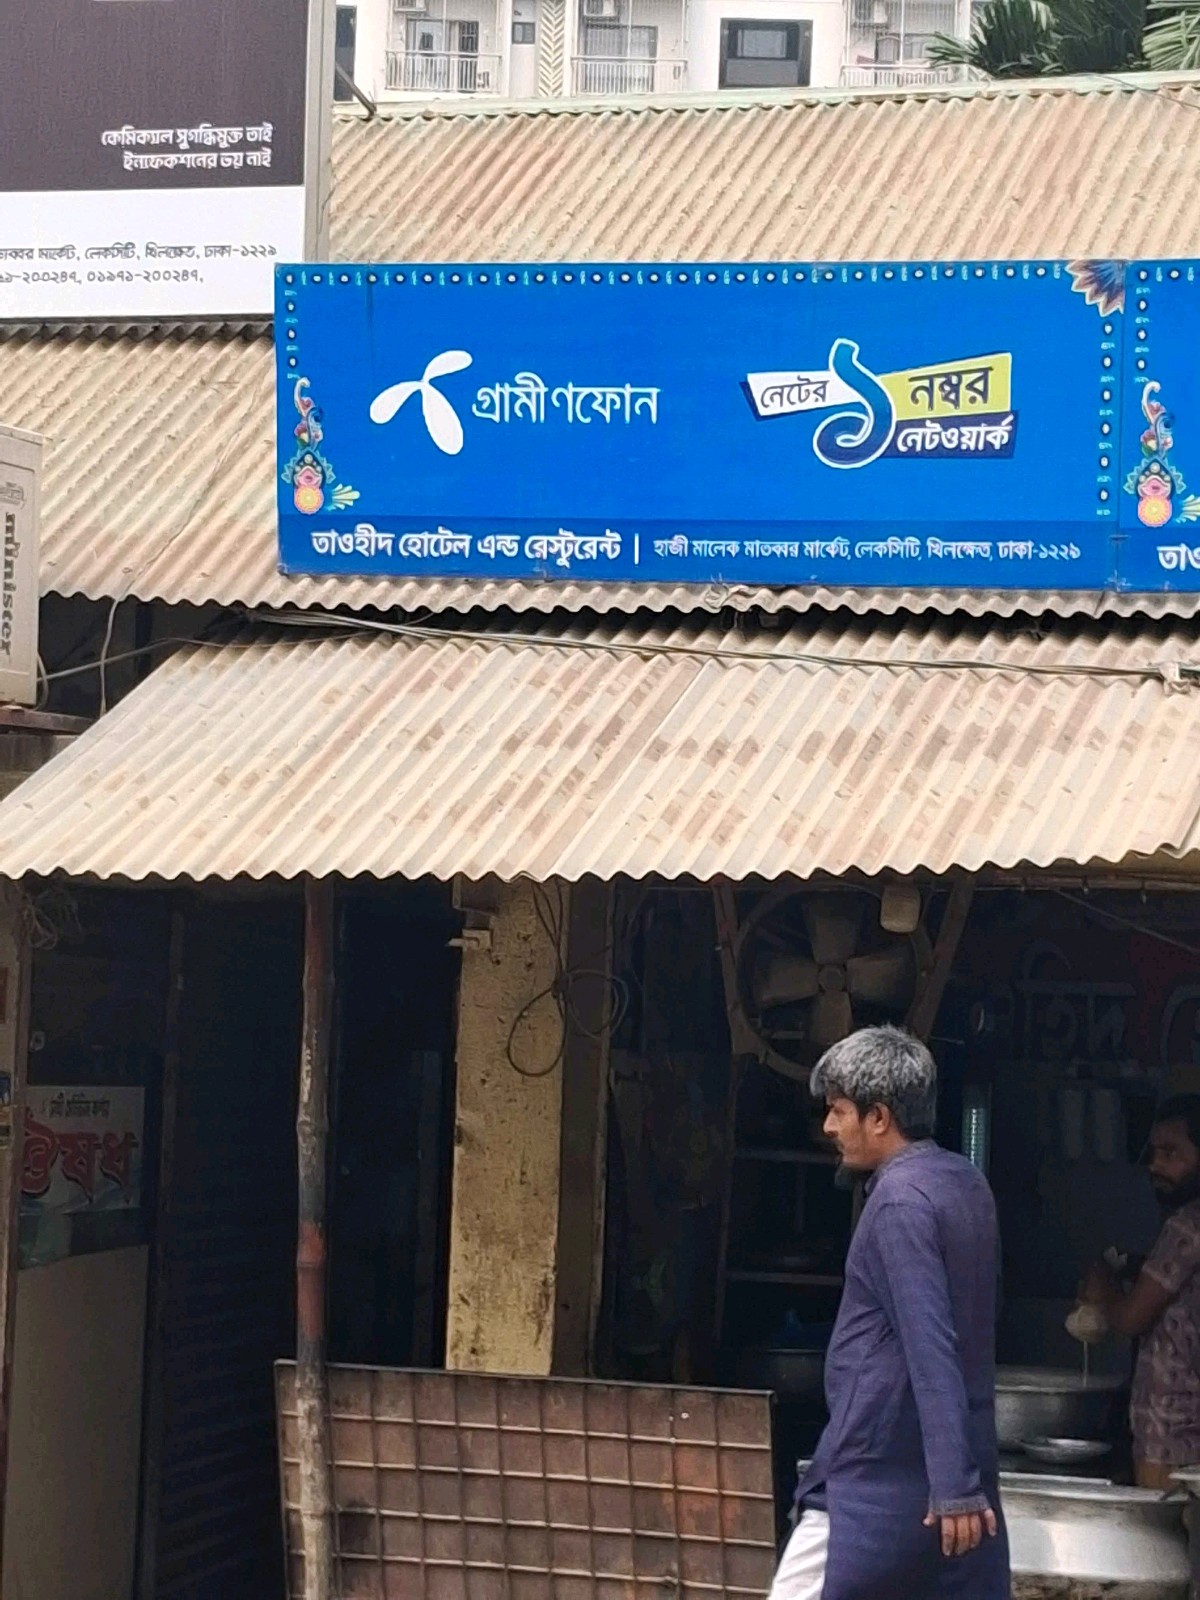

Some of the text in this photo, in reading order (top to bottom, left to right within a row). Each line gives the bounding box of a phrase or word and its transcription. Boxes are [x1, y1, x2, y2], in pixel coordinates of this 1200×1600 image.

[246, 122, 274, 144] তাই
[220, 151, 244, 169] ভয়
[246, 147, 272, 168] নাই
[472, 371, 661, 424] গ্রামীণফোন
[759, 375, 830, 409] নেটের
[908, 366, 994, 411] নম্বর
[896, 415, 1015, 453] নেটওয়ার্ক
[311, 523, 623, 568] তাওহীদ হোটেল এন্ড রেস্টুরেন্ট
[653, 534, 689, 558] হাজী
[692, 539, 740, 558] মালেক
